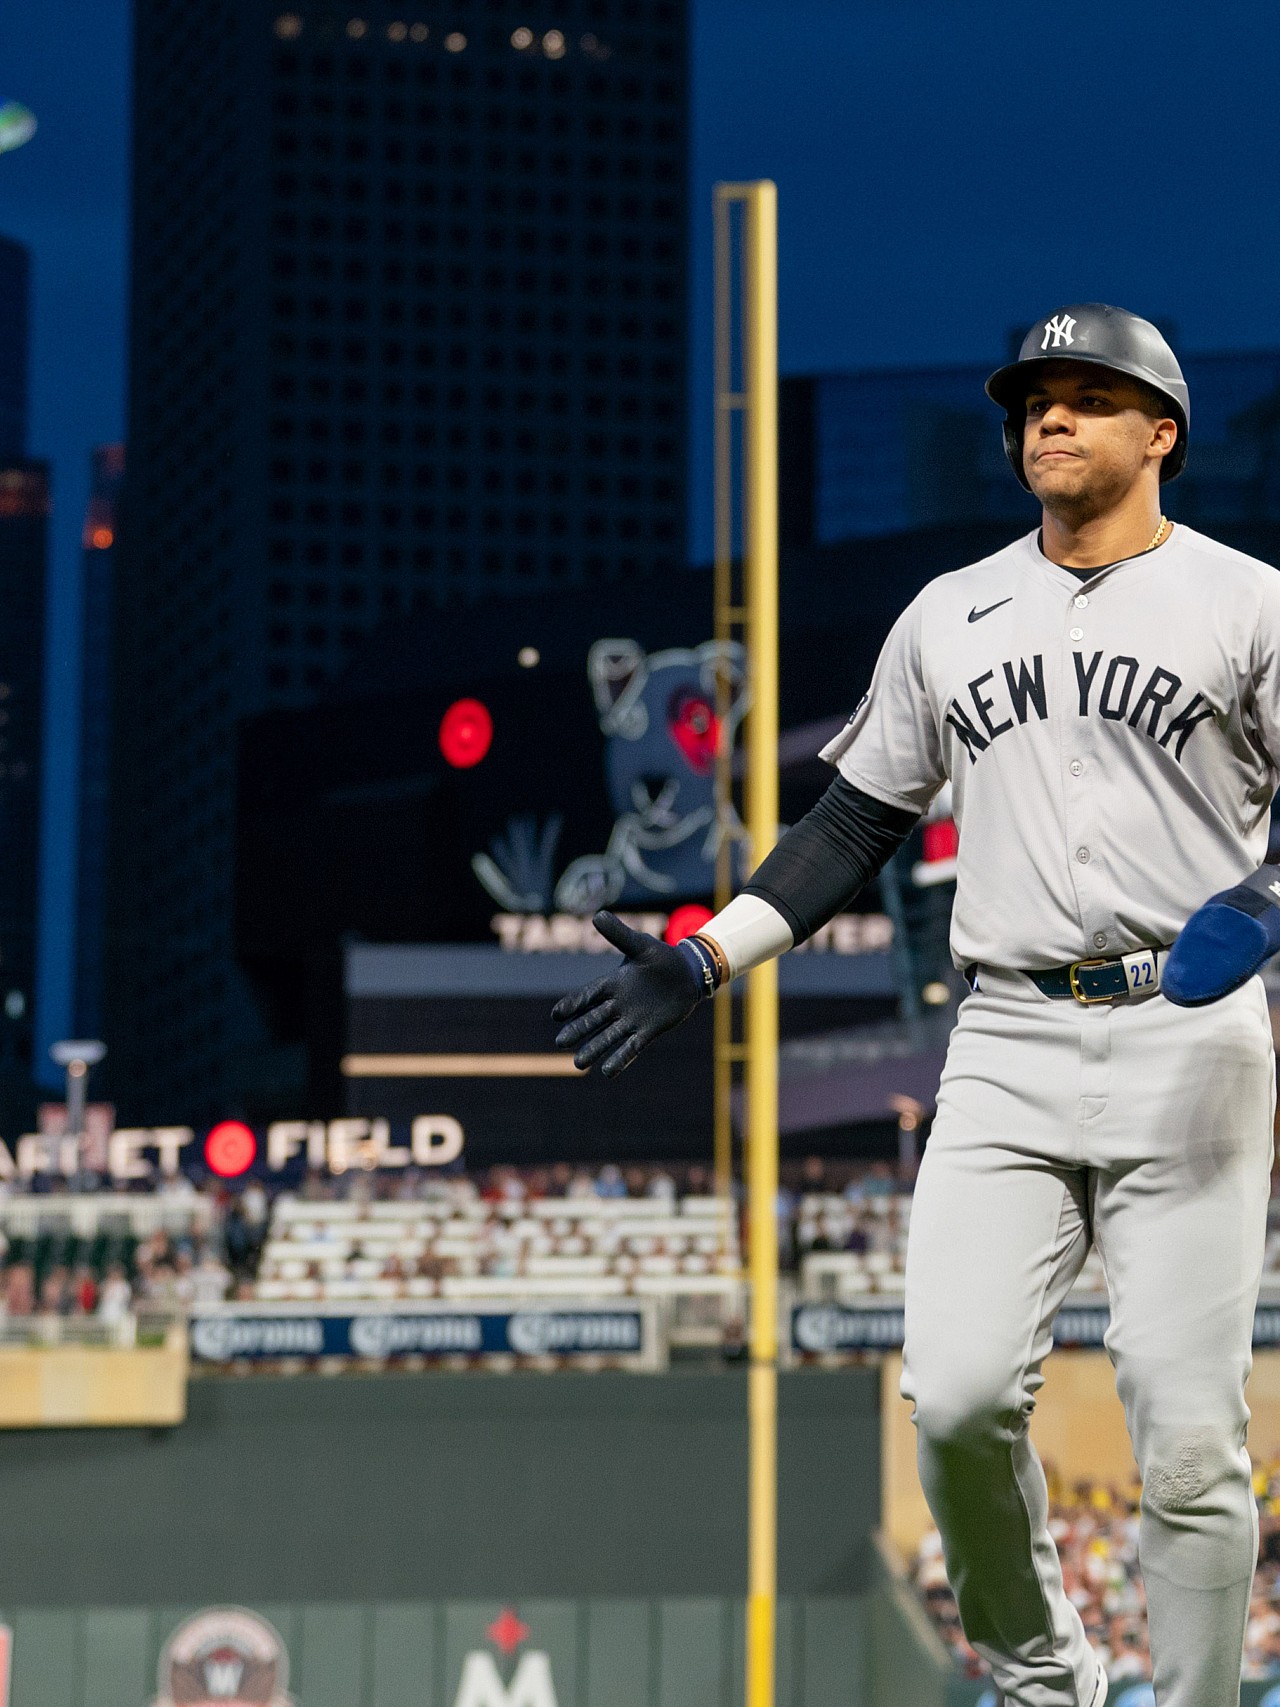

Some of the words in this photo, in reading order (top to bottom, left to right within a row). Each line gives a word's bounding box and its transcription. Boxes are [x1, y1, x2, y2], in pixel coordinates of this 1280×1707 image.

[1040, 313, 1077, 350] NY
[945, 654, 1049, 765] NEW
[1072, 650, 1217, 764] YORK
[1130, 962, 1154, 988] 22
[266, 1114, 464, 1174] FIELD
